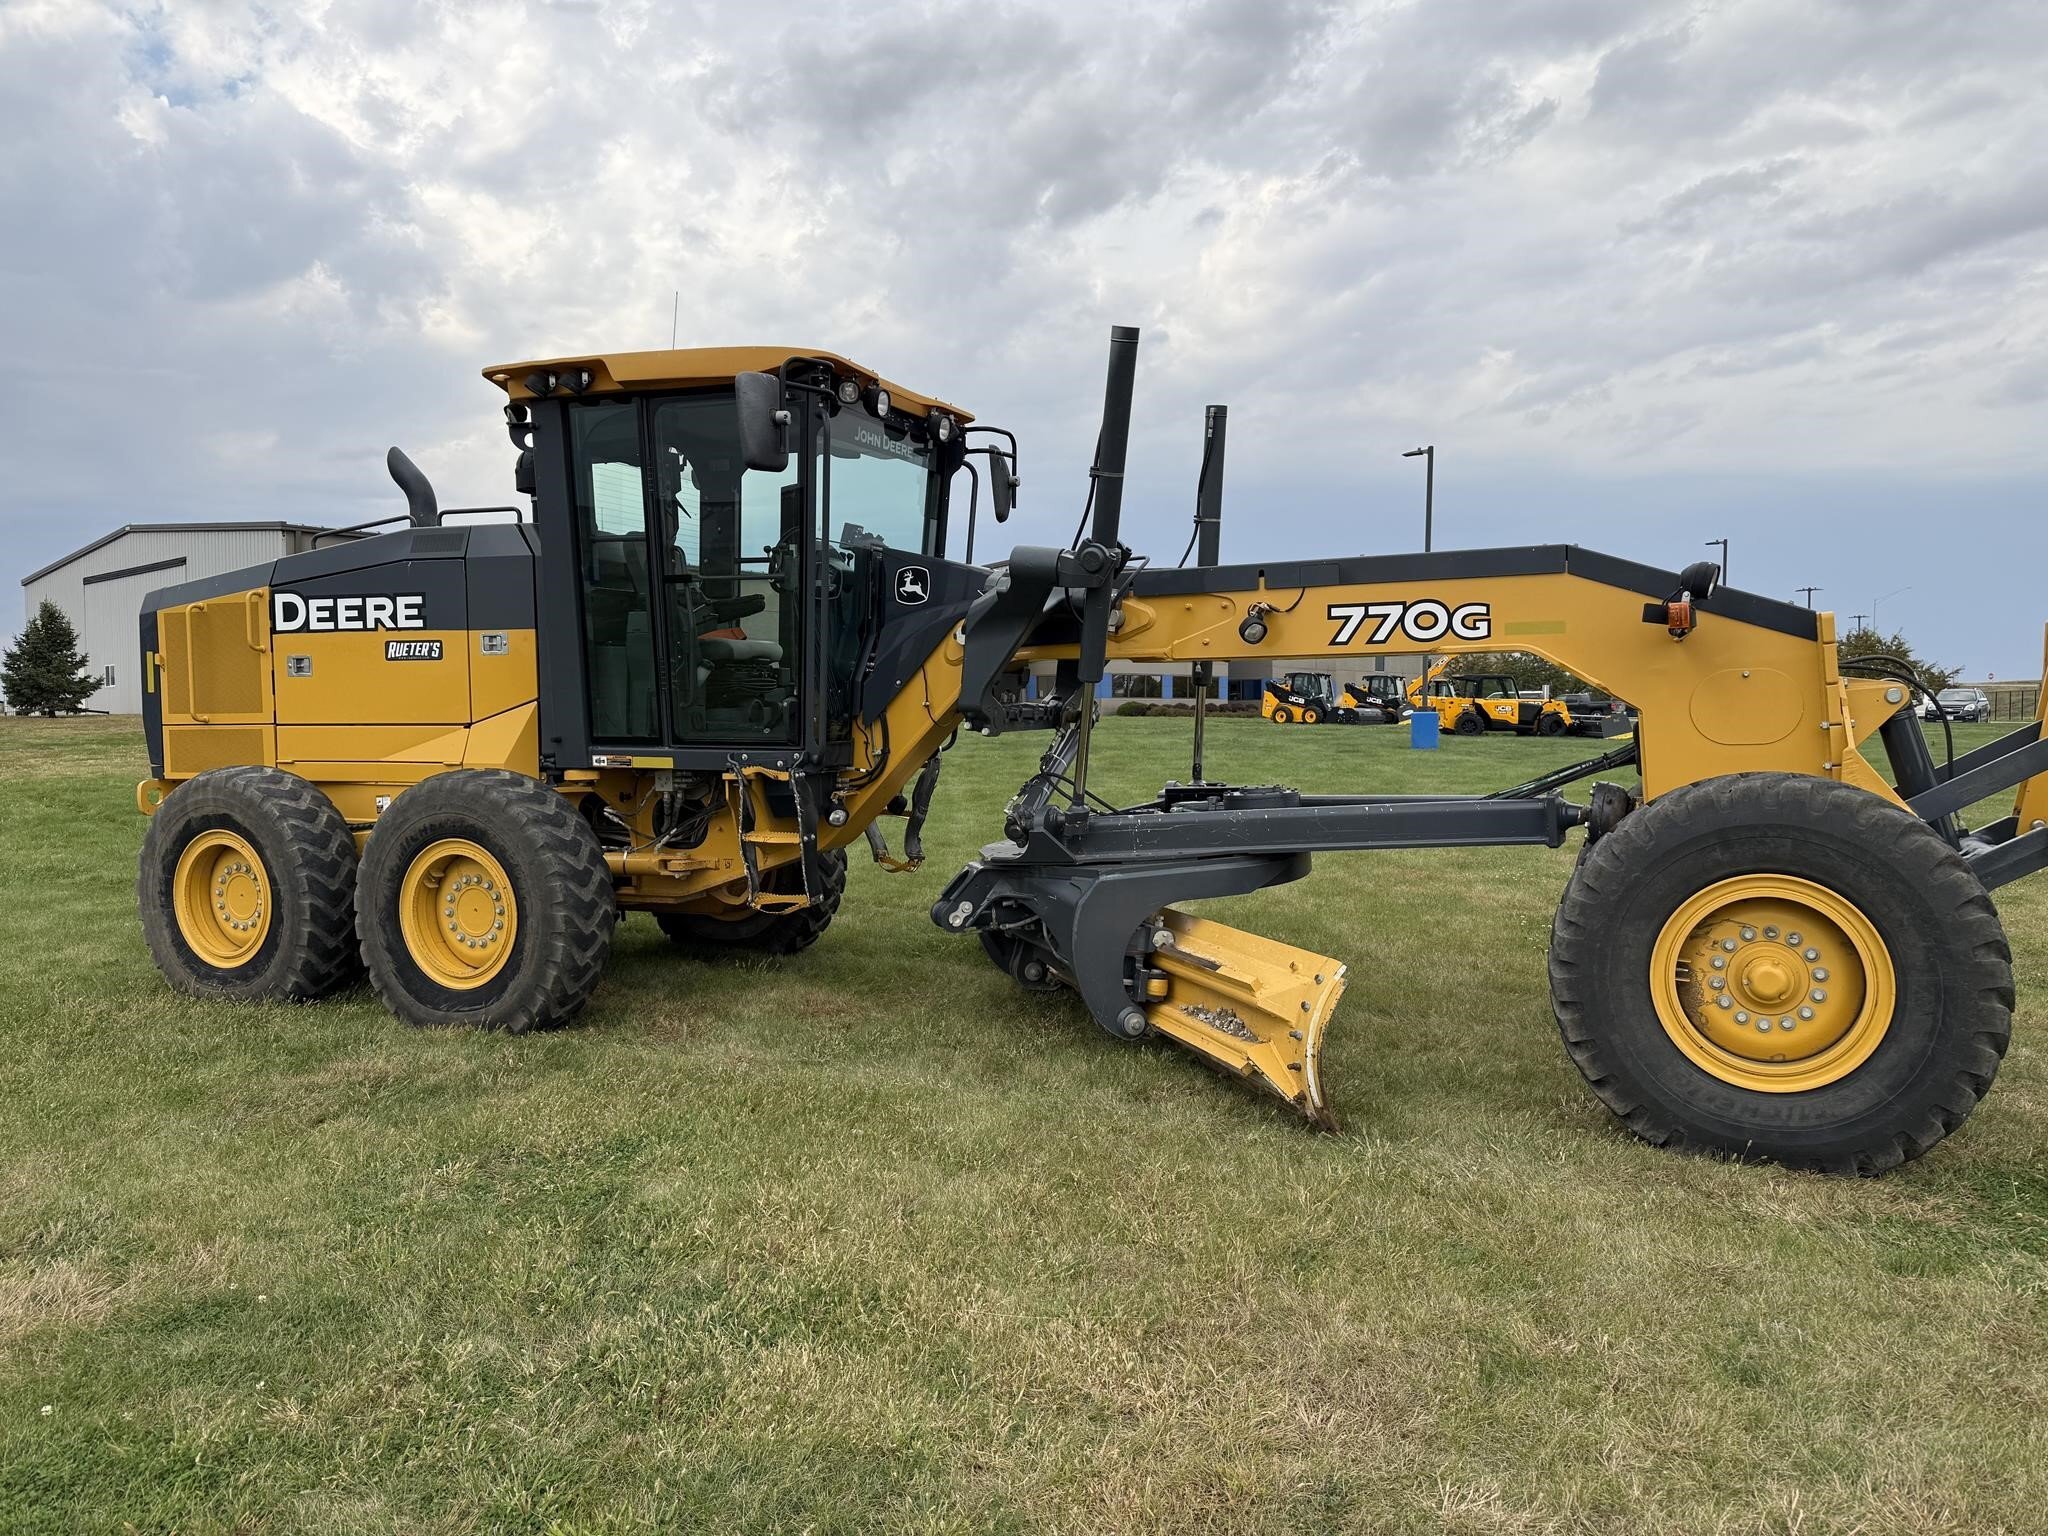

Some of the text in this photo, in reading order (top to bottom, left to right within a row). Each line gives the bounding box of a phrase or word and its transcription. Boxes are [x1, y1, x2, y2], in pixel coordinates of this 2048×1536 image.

[854, 425, 914, 458] JOHN DEERE
[274, 592, 424, 631] DEERE
[1329, 600, 1490, 645] 770G
[387, 641, 441, 659] RUETER'S
[1288, 695, 1305, 704] JCB
[1366, 696, 1382, 704] JCB
